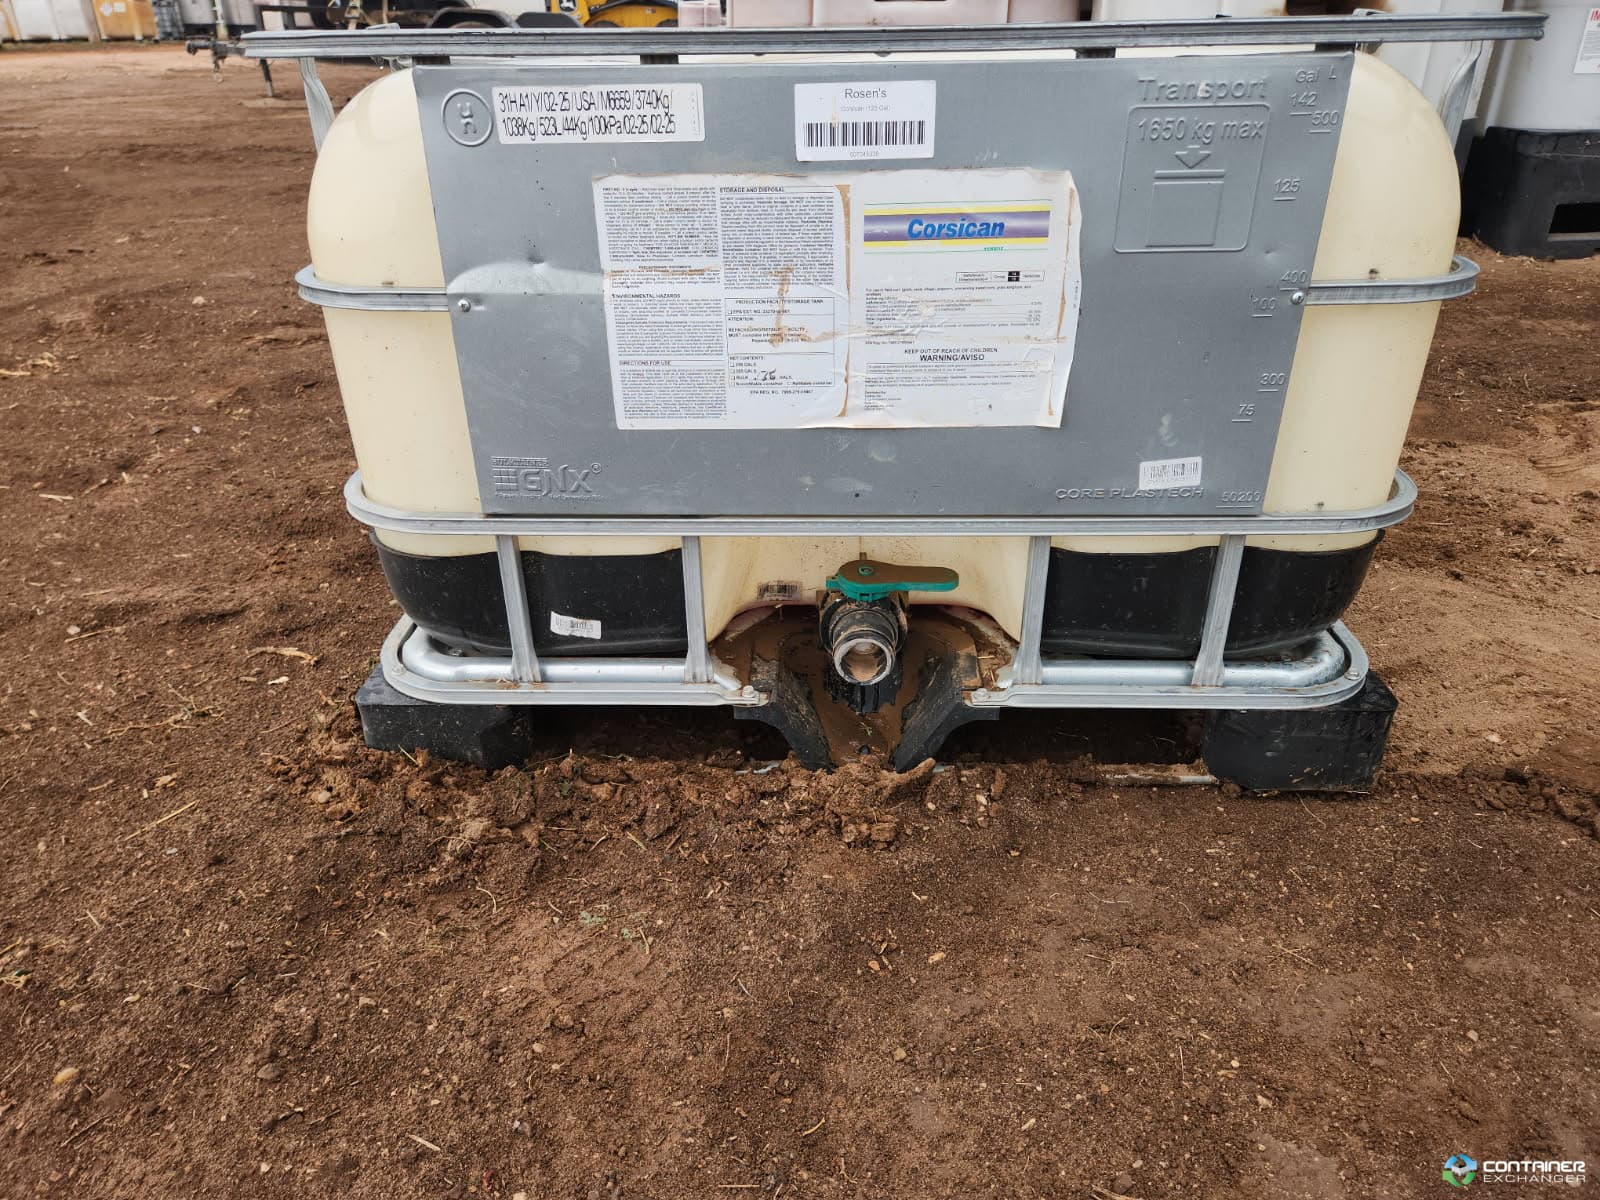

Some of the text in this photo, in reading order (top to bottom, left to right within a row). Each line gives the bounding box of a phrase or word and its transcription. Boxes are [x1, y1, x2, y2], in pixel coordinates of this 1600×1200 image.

[1295, 66, 1337, 83] Gal L
[845, 87, 887, 99] Rosen's
[1138, 76, 1268, 103] Transport
[1290, 91, 1318, 107] 142
[1311, 110, 1340, 126] 500
[1191, 115, 1213, 144] kg
[1220, 118, 1265, 140] max
[1274, 178, 1301, 193] 125
[907, 217, 1005, 239] Corsican
[1280, 271, 1308, 283] 400
[1252, 297, 1277, 310] 100
[920, 354, 985, 362] WARNING/AVISO
[1260, 373, 1286, 386] 300
[1239, 404, 1256, 416] 75
[1055, 487, 1204, 499] CORE PLASTECH
